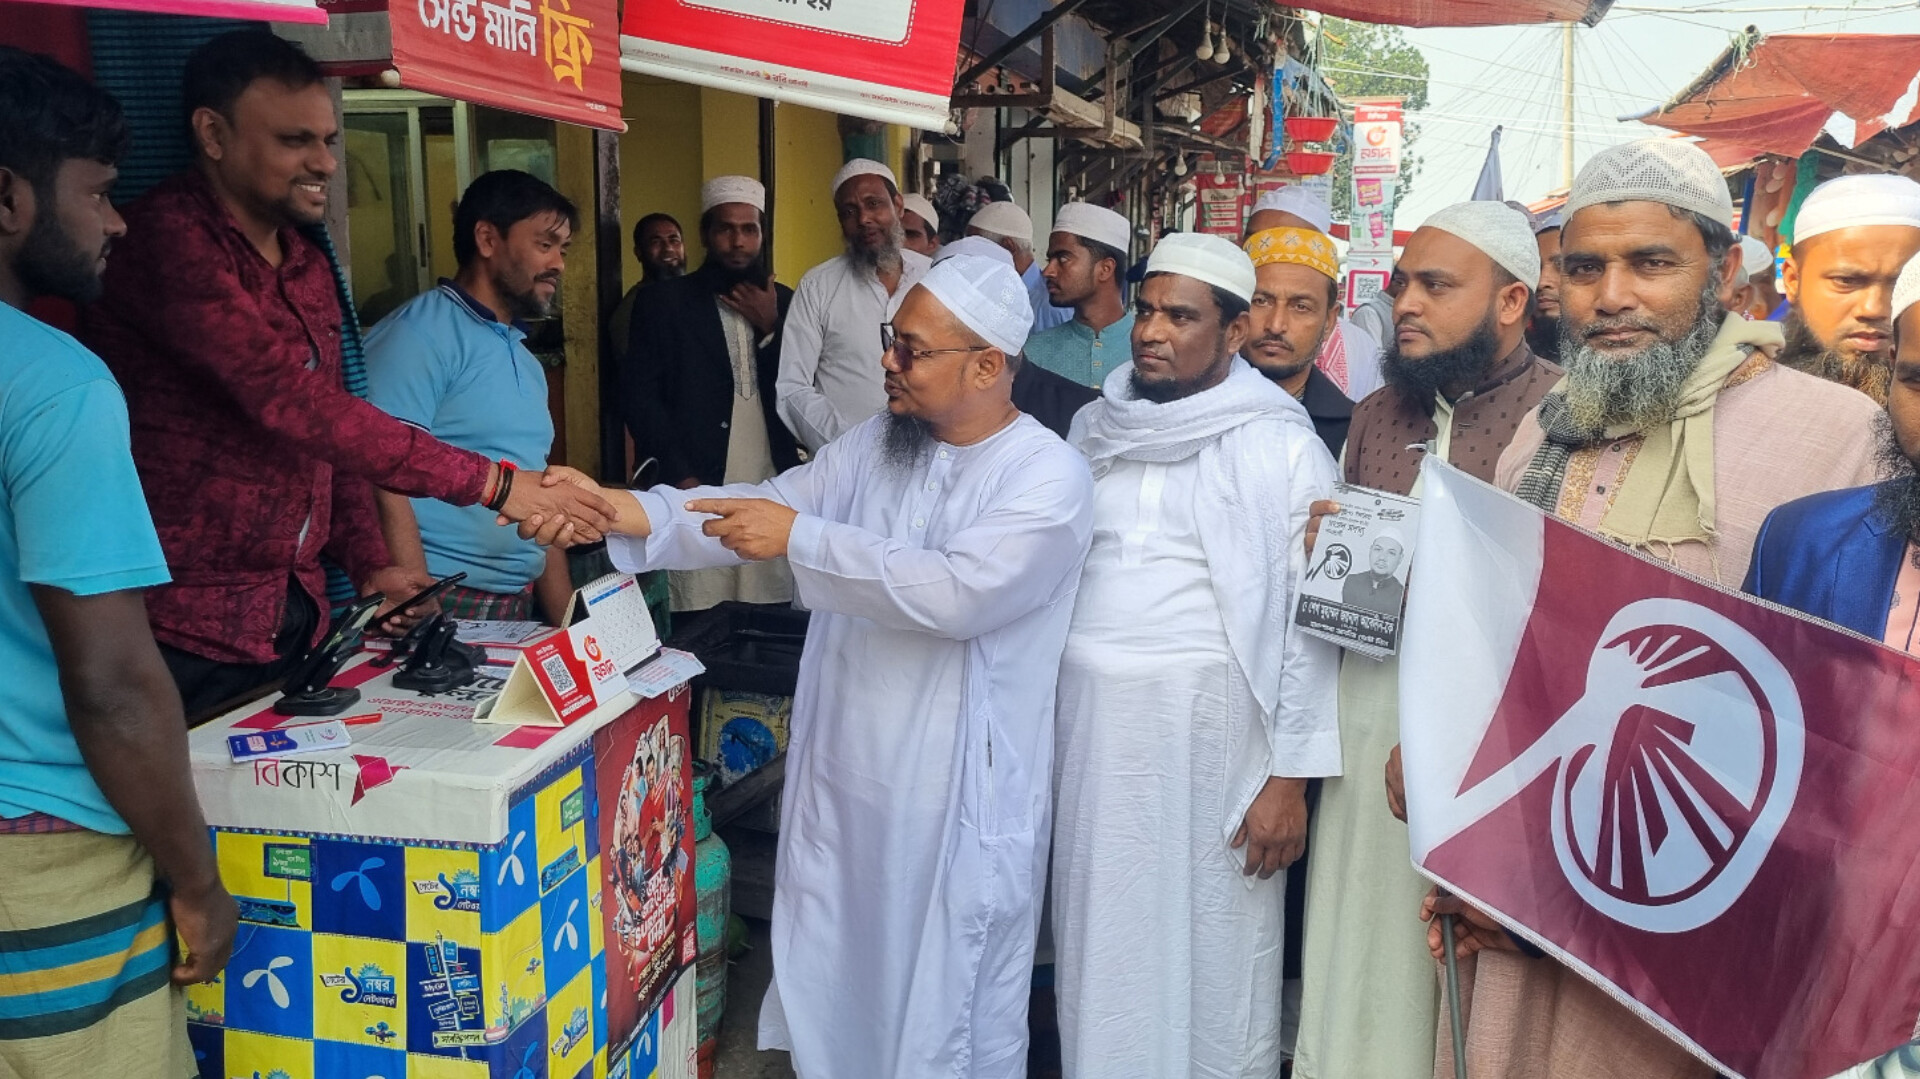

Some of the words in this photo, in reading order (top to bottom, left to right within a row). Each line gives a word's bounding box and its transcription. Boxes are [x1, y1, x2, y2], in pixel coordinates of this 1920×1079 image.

[482, 0, 536, 56] মানি
[540, 0, 594, 91] ফ্রি
[255, 758, 341, 790] বিকাশ
